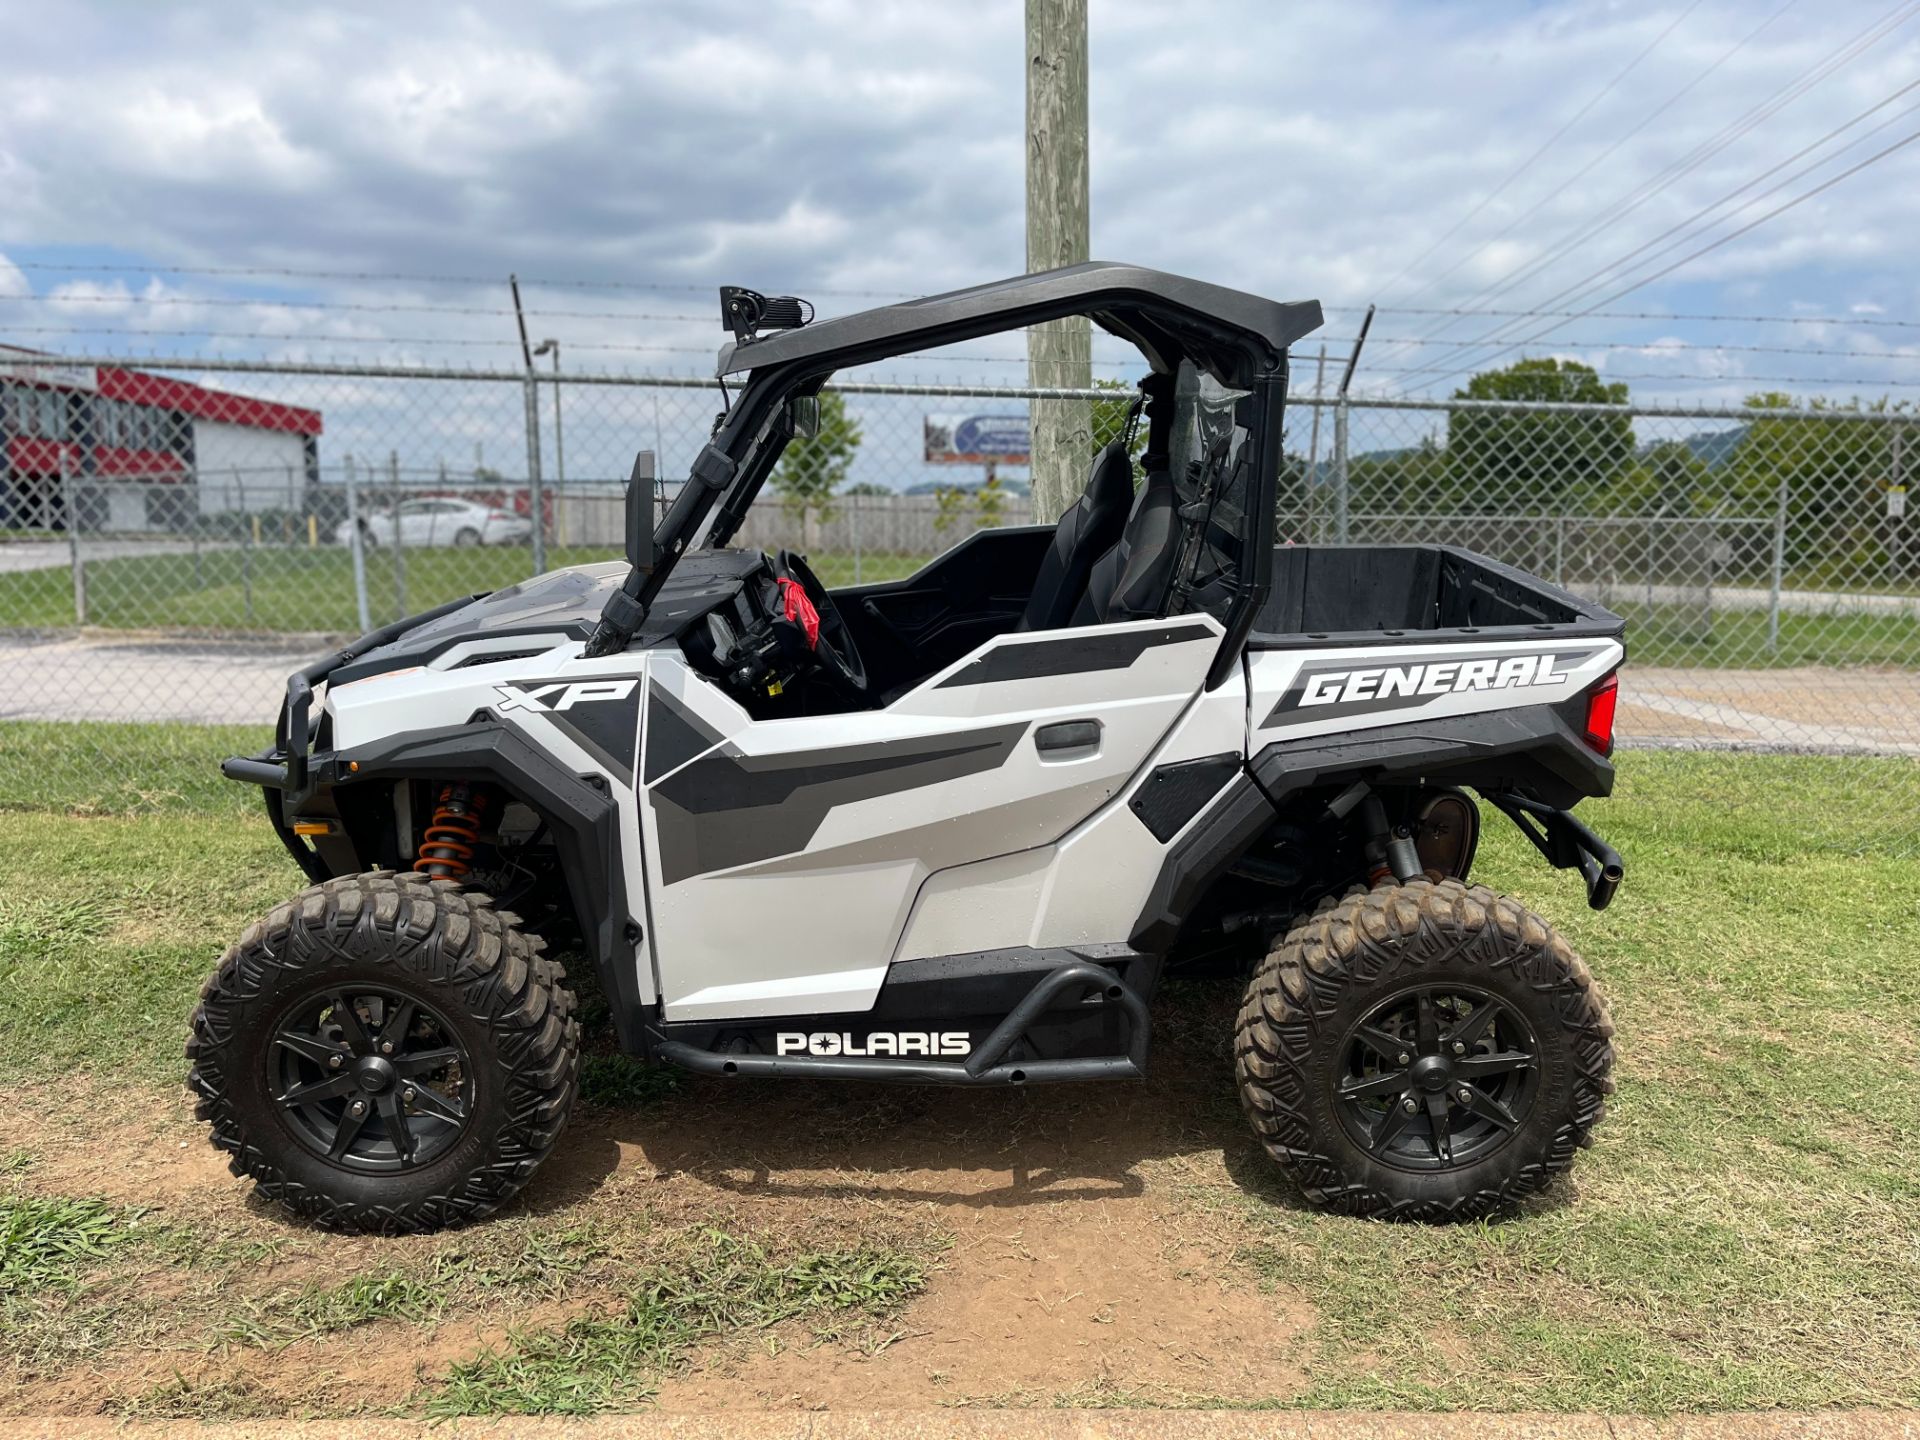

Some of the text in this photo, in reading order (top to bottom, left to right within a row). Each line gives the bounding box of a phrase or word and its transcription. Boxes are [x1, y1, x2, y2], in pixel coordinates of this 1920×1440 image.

[493, 679, 639, 713] XP
[1298, 654, 1568, 707] GENERAL
[776, 1031, 971, 1056] POLARIS
